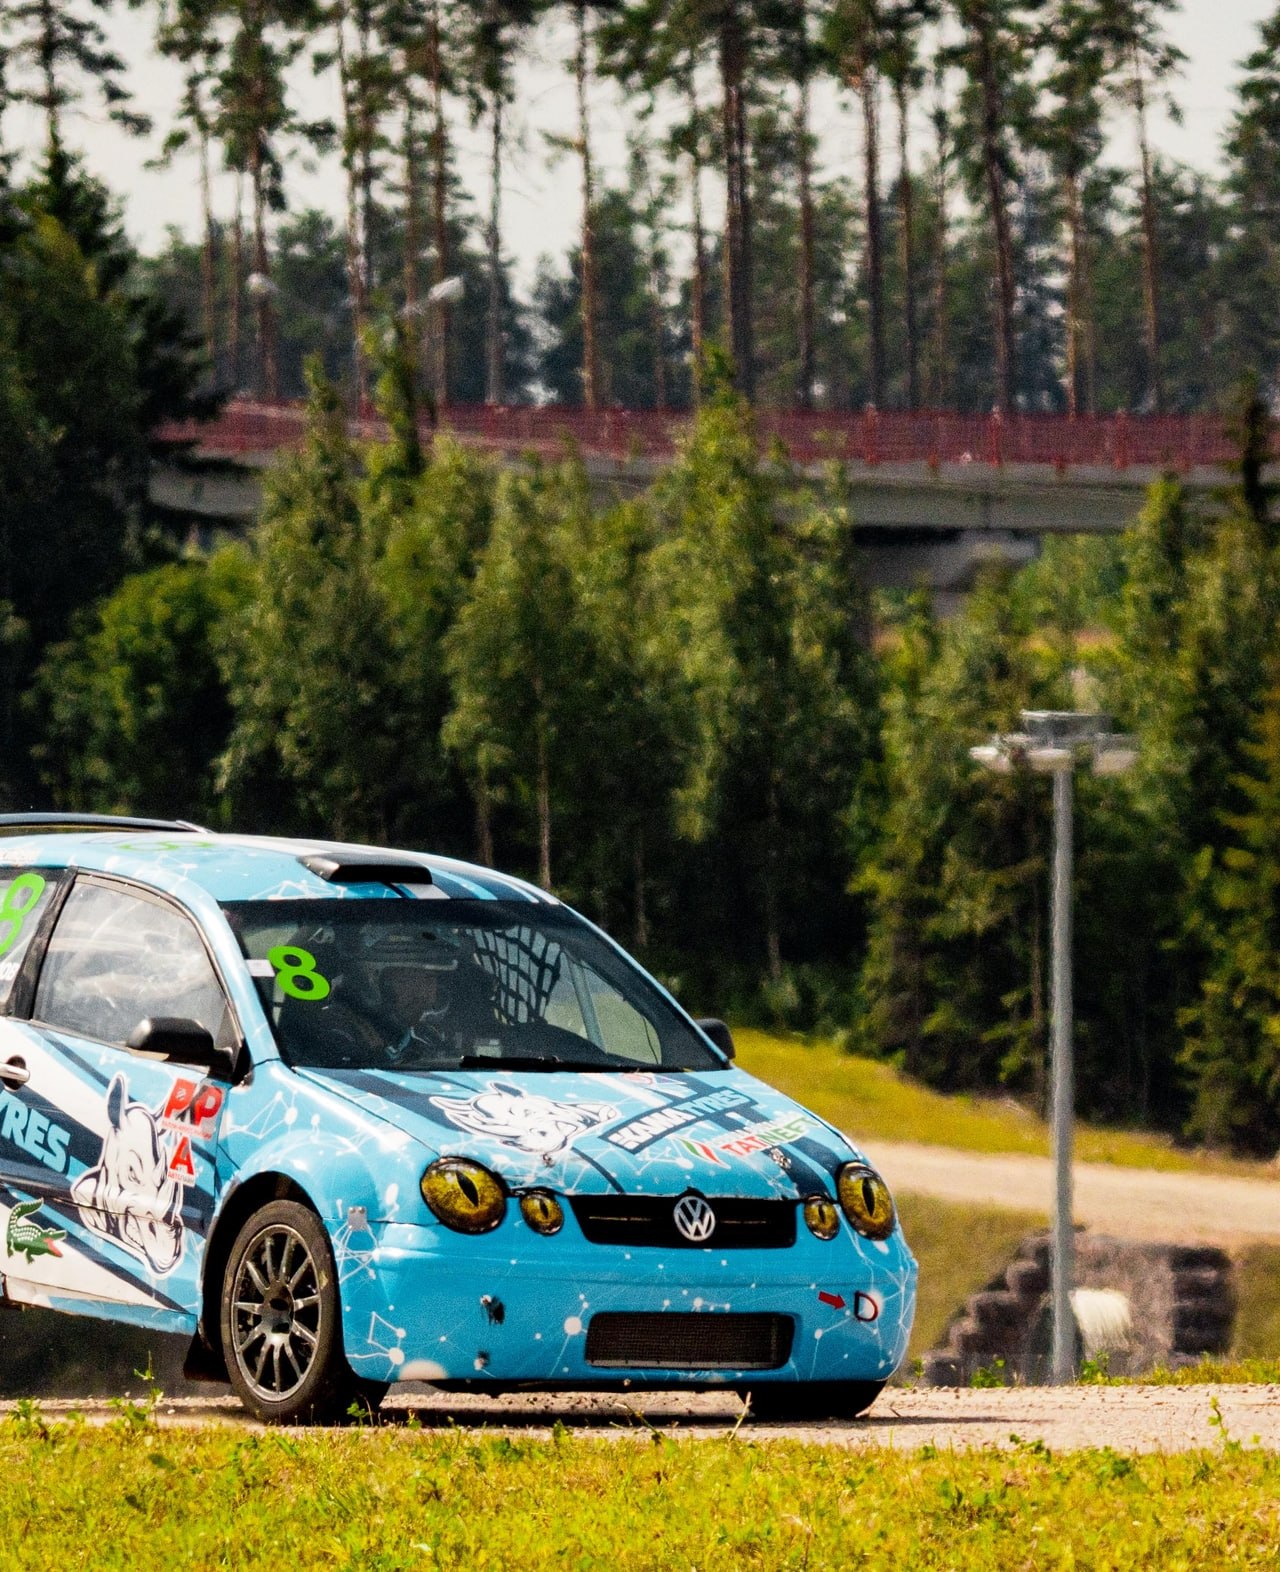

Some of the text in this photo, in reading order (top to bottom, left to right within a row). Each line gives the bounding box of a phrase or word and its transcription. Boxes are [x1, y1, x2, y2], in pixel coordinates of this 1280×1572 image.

[267, 945, 331, 1001] 8
[607, 1108, 698, 1150] KAMA
[673, 1089, 752, 1117] TYRES
[720, 1115, 819, 1157] TATNEFT
